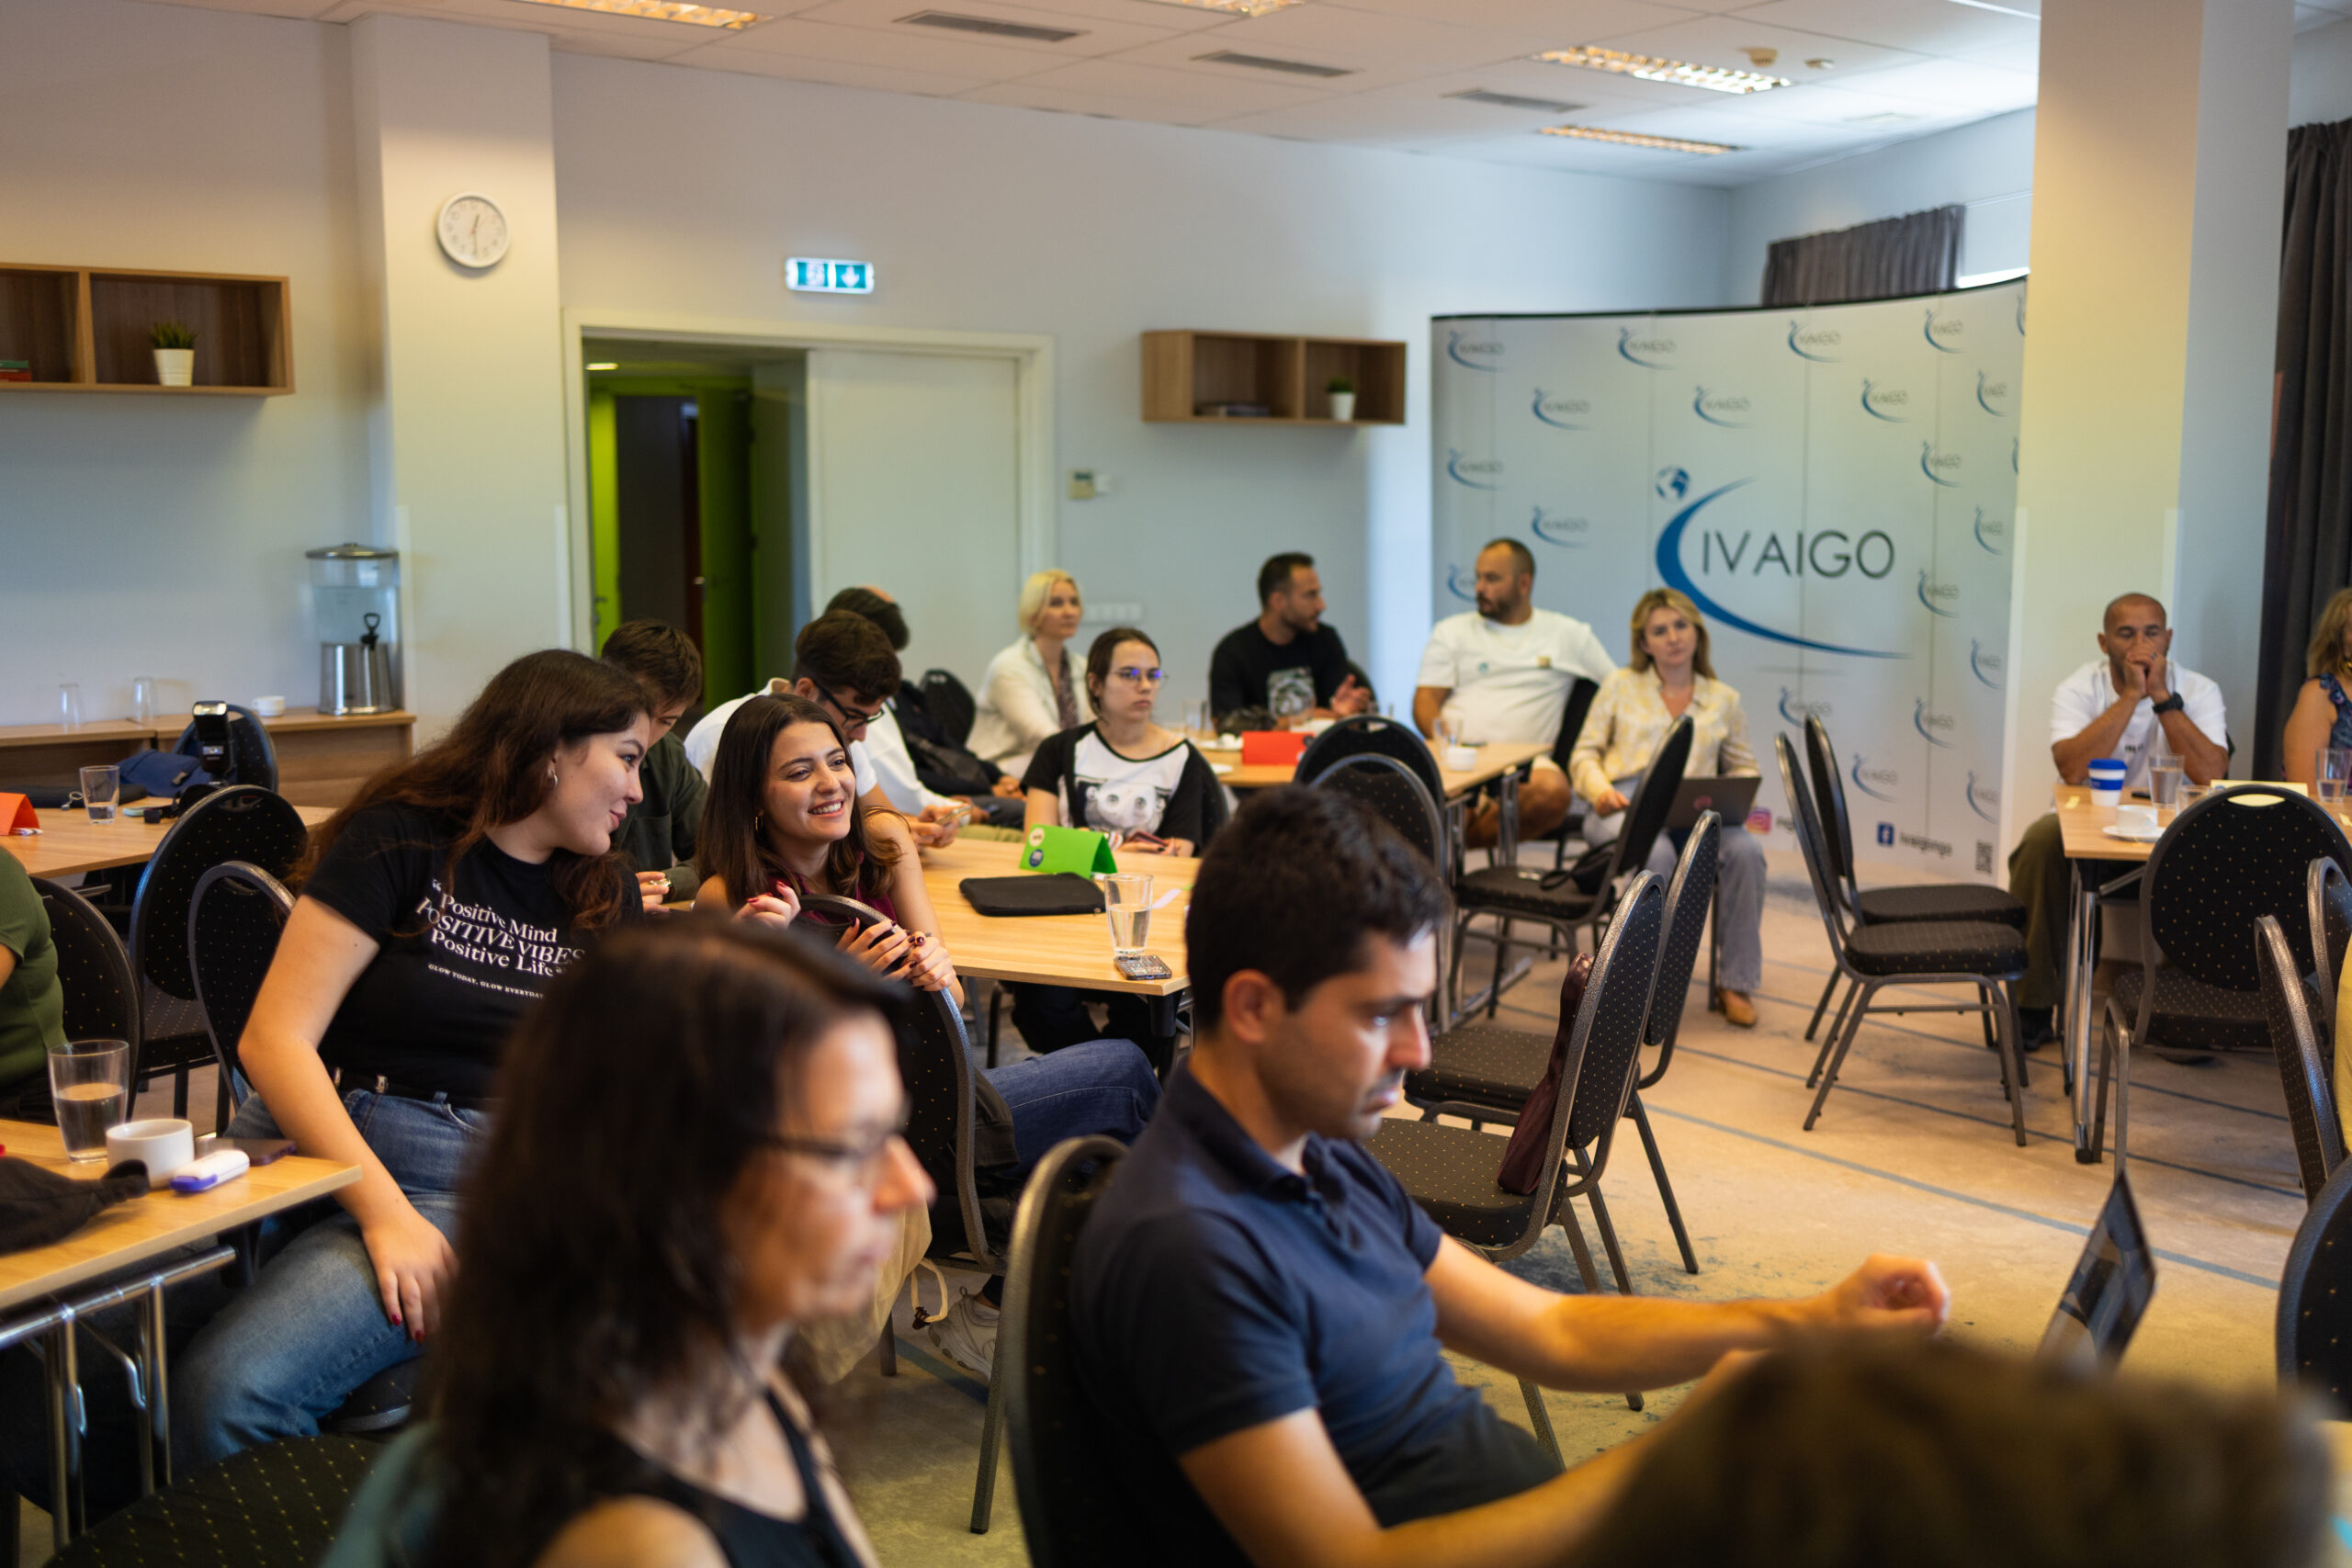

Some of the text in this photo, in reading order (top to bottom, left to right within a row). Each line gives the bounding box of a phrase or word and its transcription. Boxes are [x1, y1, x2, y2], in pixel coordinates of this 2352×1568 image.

[1702, 529, 1894, 580] IVAIGO
[415, 897, 515, 950] POSITIVE
[509, 919, 558, 943] Mind
[431, 928, 511, 967] Positive
[428, 964, 451, 976] GLOW
[480, 981, 503, 991] GLOW
[504, 987, 544, 999] EVERYDAY
